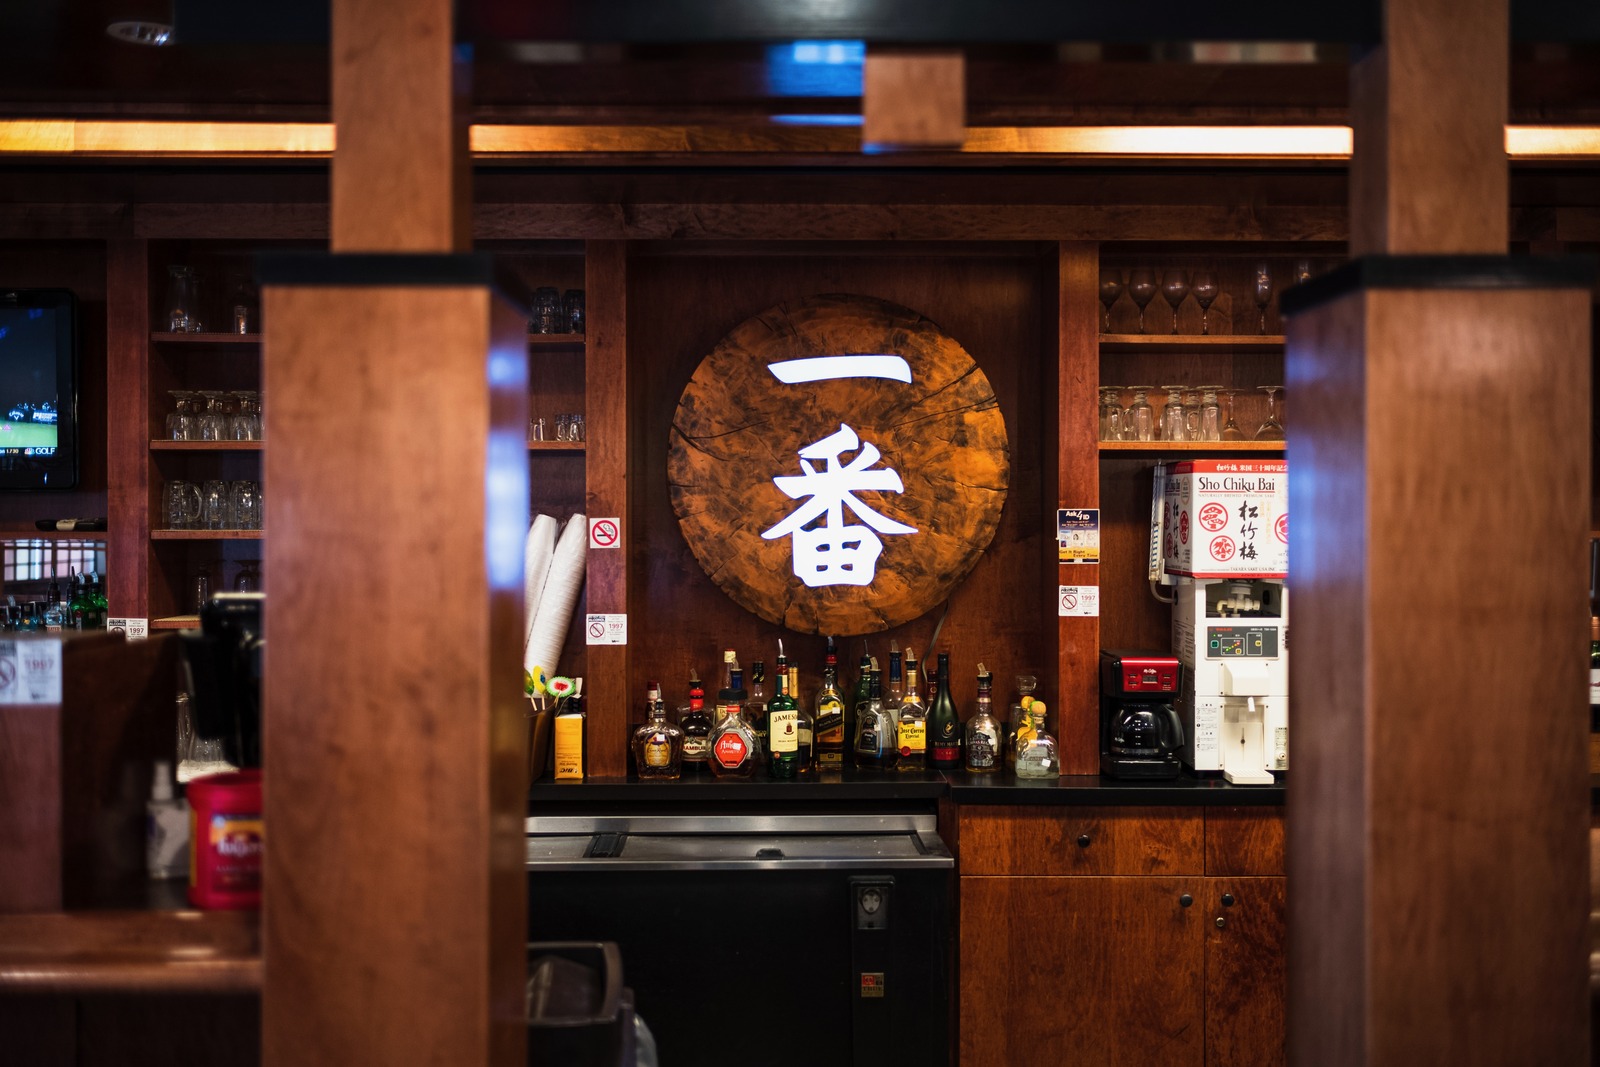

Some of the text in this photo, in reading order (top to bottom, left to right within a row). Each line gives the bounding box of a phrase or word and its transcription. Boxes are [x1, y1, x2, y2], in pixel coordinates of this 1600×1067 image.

[35, 447, 56, 455] GOLF
[761, 355, 919, 588] 一番
[1198, 476, 1221, 491] Sho
[1223, 476, 1255, 493] Chiku
[1258, 477, 1275, 491] Bai
[1076, 510, 1083, 521] 4
[1238, 500, 1259, 561] 松竹梅
